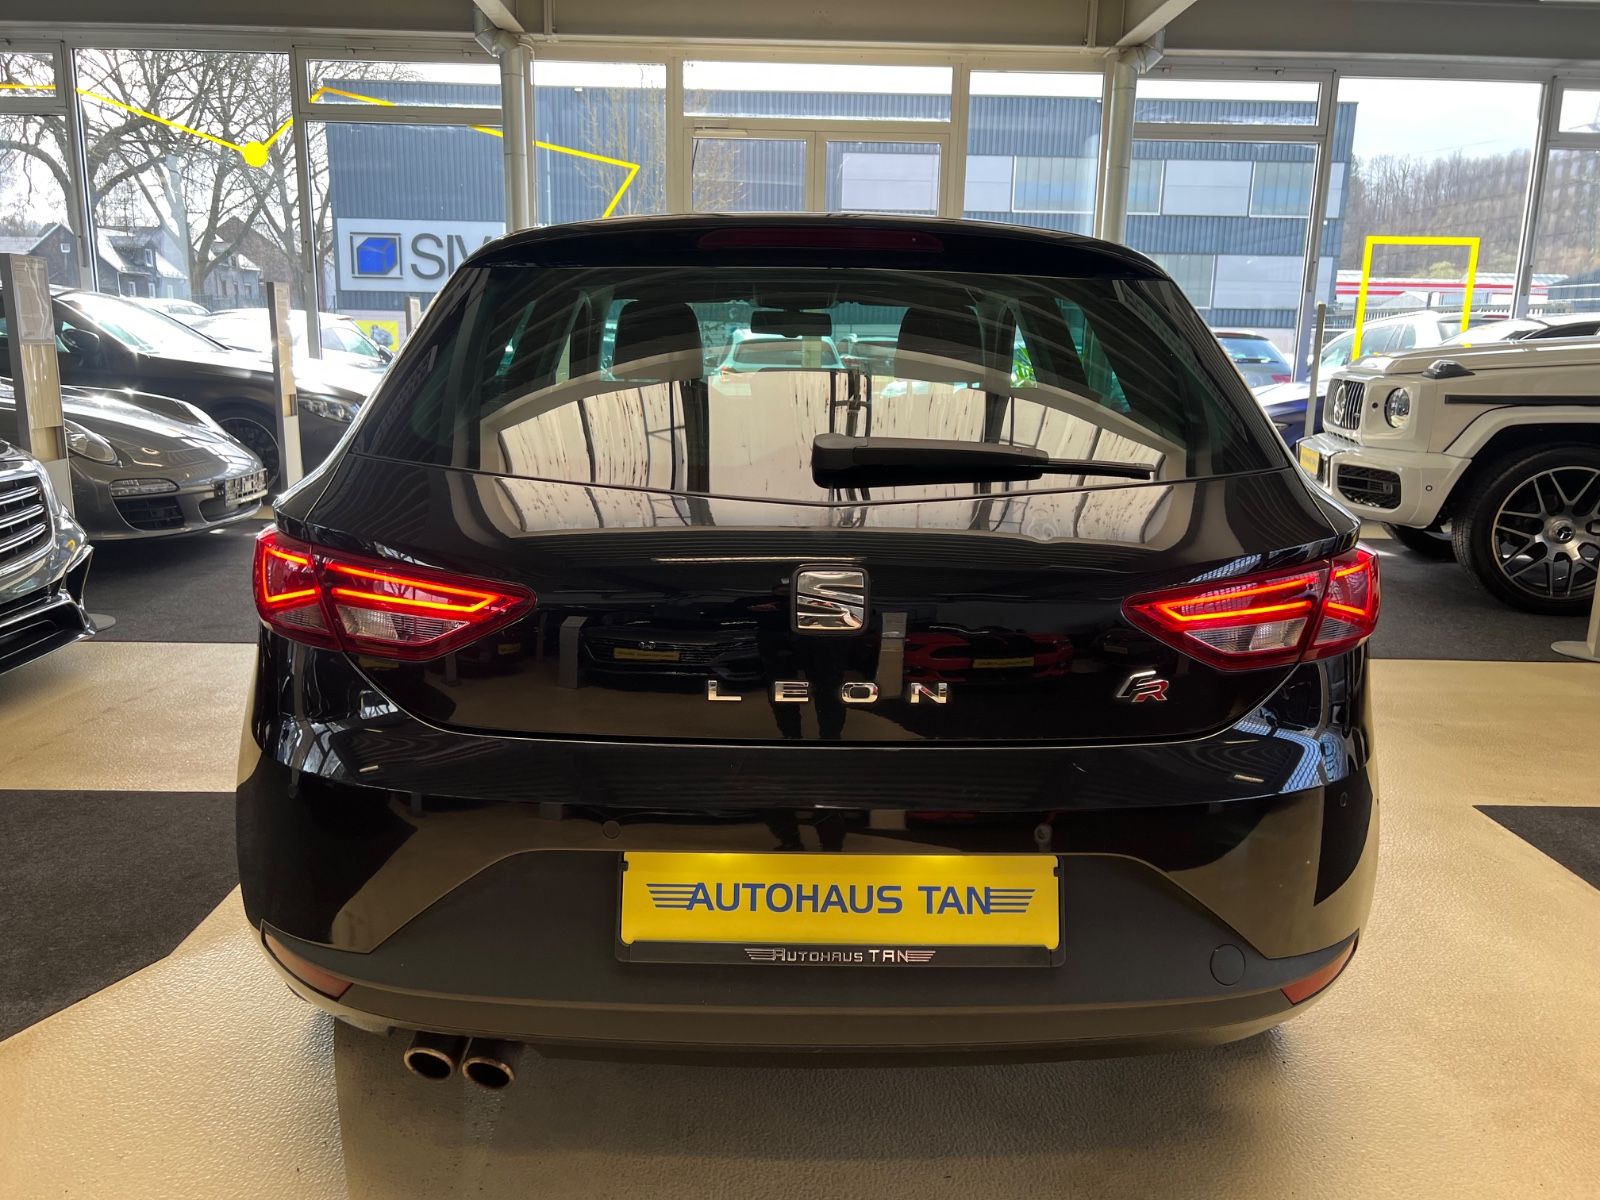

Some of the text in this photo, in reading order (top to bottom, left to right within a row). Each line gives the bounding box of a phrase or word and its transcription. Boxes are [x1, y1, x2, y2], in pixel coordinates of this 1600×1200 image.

[707, 679, 947, 704] LEON
[1116, 670, 1169, 702] FR
[685, 882, 992, 915] AUTOHAUS TAN
[868, 949, 909, 963] TAN
